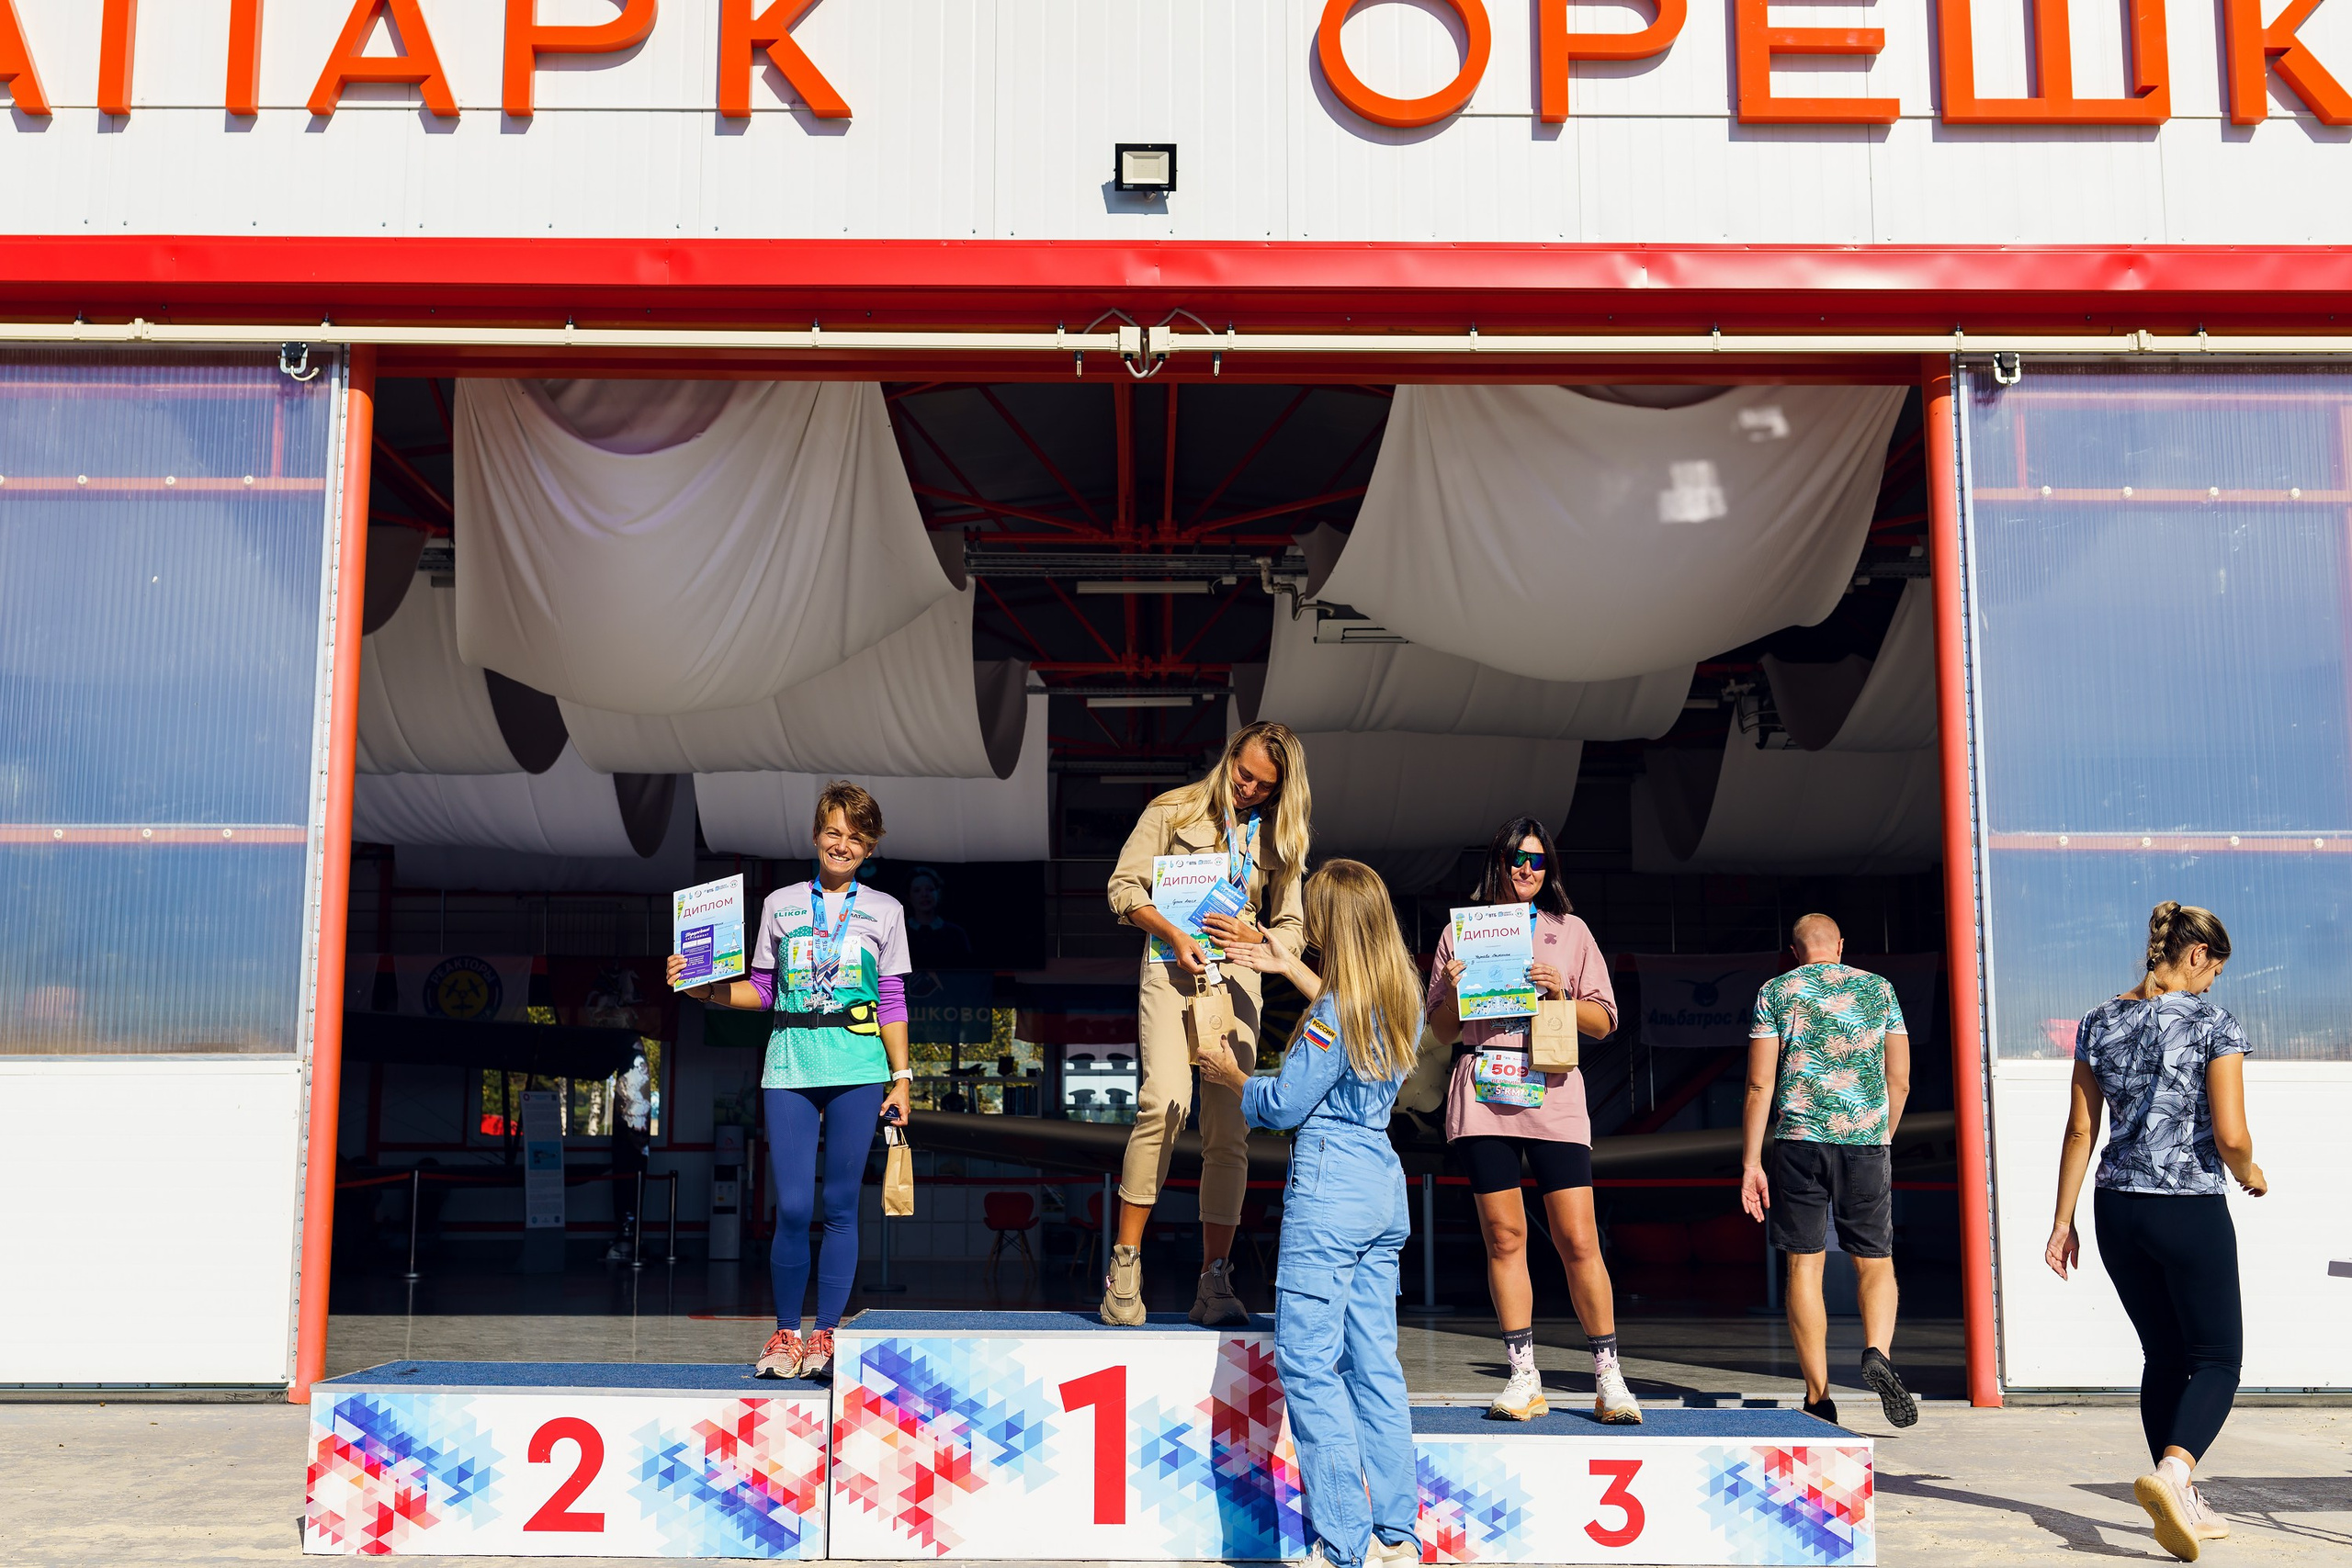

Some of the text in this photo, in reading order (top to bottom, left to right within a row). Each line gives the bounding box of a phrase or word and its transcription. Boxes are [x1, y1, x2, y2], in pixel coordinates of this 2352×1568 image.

[0, 0, 852, 118] ПАРК
[1163, 875, 1217, 886] ДИПЛОМ
[684, 897, 733, 919] ДИПЛОМ
[775, 909, 808, 919] ELIKOR
[1464, 927, 1521, 941] ДИПЛОМ
[430, 958, 496, 984] РЕАКТОРЫ
[1313, 1021, 1335, 1037] РОССИЯ
[1647, 1009, 1732, 1029] Альбатрос
[1491, 1063, 1530, 1077] 509
[1495, 1086, 1502, 1095] 5
[1058, 1365, 1126, 1525] 1
[523, 1416, 605, 1532] 2
[1584, 1460, 1645, 1548] 3
